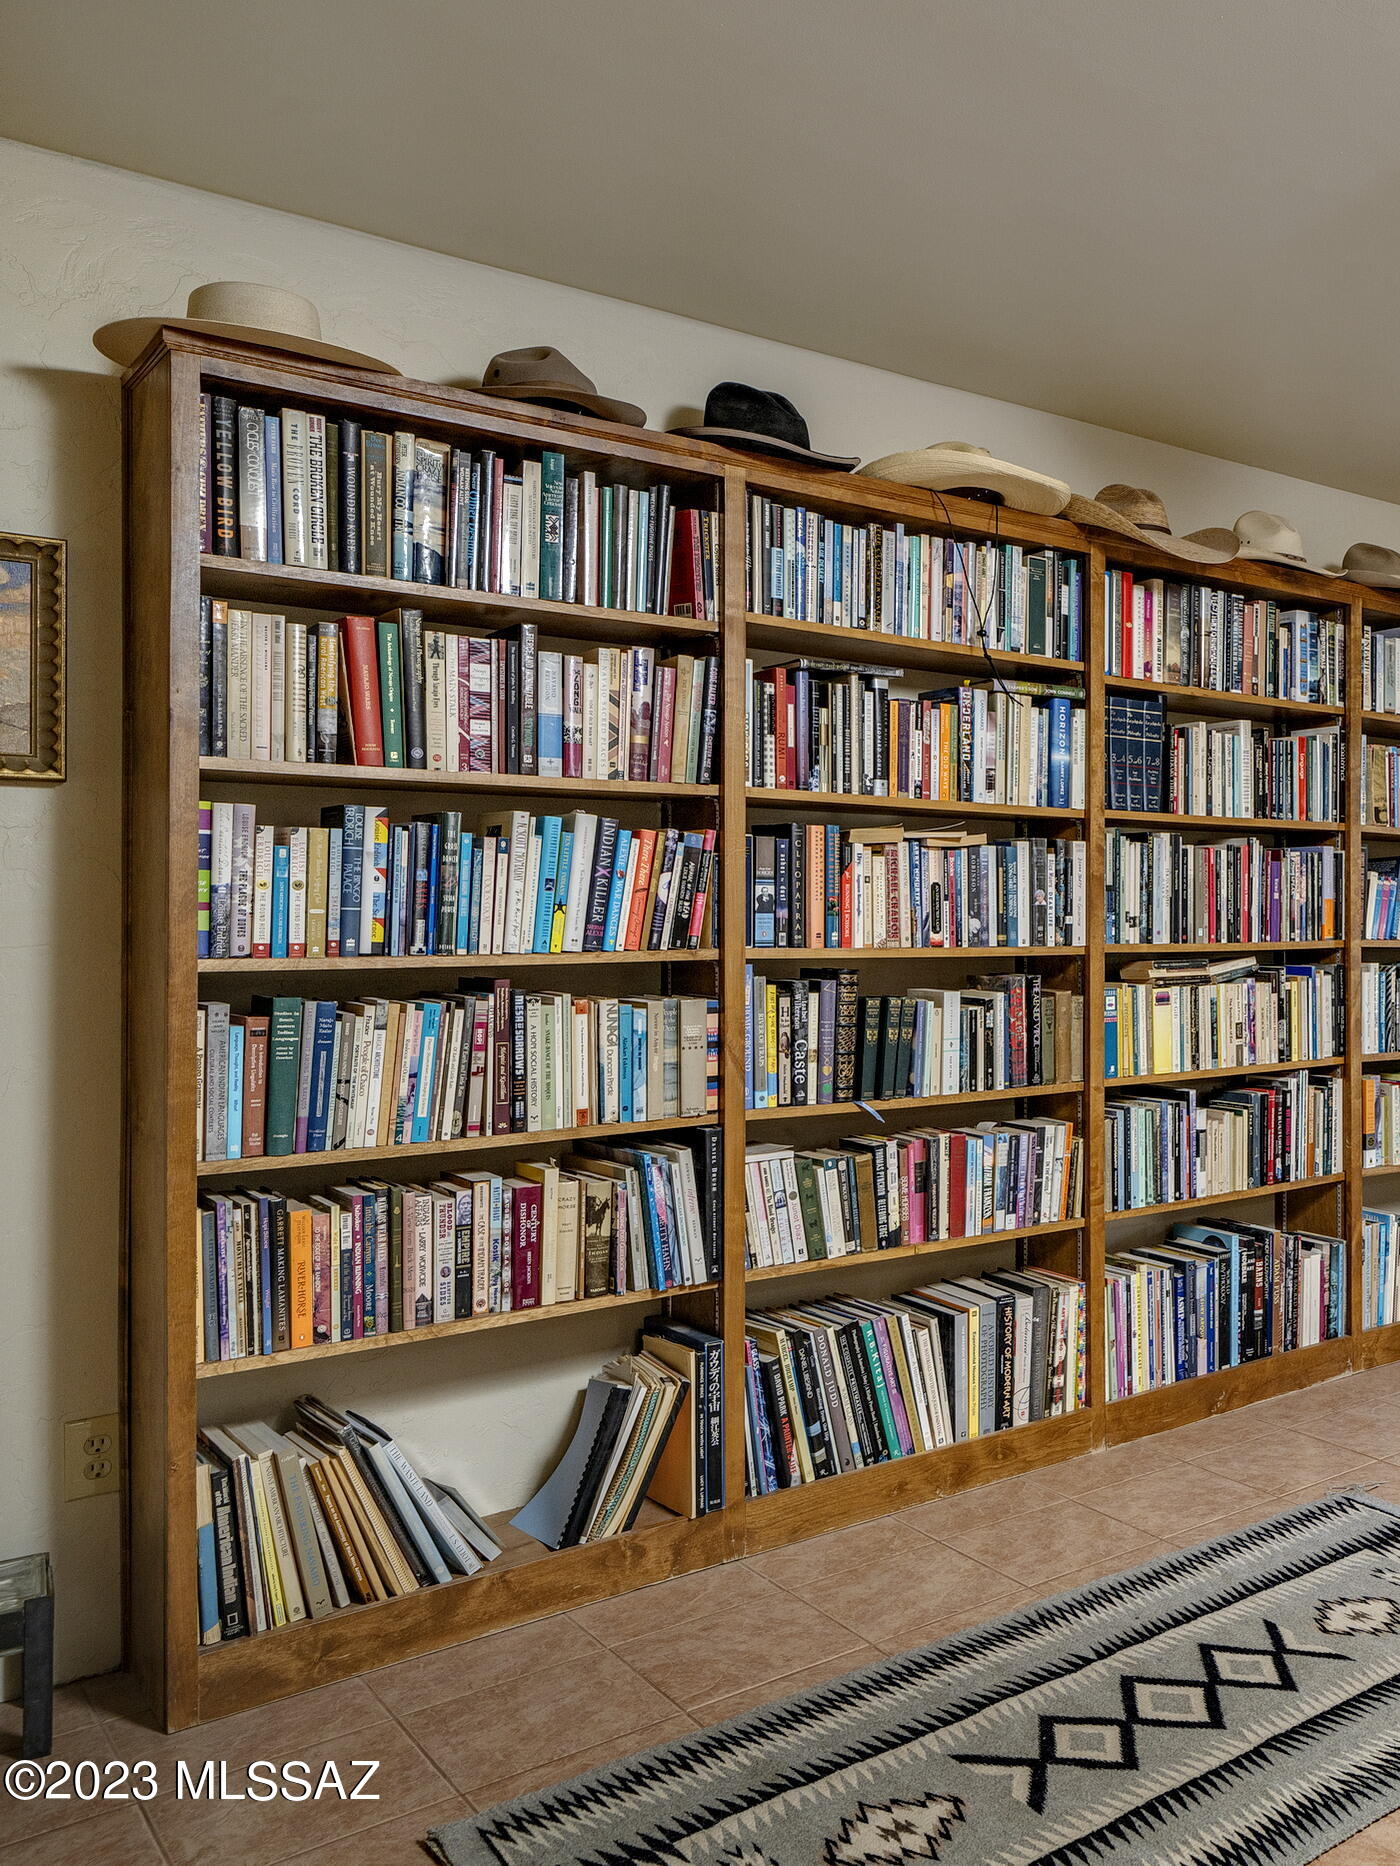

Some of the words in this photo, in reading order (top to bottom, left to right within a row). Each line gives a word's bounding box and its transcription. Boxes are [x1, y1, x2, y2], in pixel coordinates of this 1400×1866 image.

[216, 419, 233, 489] YELLOW
[309, 435, 322, 456] THE
[287, 444, 304, 486] BROKEN
[370, 465, 375, 475] at
[310, 459, 323, 504] BROKEN
[347, 467, 355, 521] WOUNDED
[395, 470, 406, 496] INDIAN
[376, 497, 382, 510] My
[395, 497, 407, 534] COUNTRY
[469, 490, 477, 519] Other
[217, 497, 234, 538] BIRD
[311, 506, 324, 544] CIRCLE
[347, 524, 356, 552] KNEE
[467, 522, 477, 565] Destinies
[230, 619, 239, 642] JERRY
[240, 620, 247, 632] IN
[320, 638, 328, 656] Rural
[525, 633, 534, 654] FIERCE
[231, 644, 239, 677] MANDER
[240, 650, 248, 682] ABSENCE
[328, 638, 337, 679] Electrifying
[525, 655, 534, 667] AND
[362, 664, 370, 689] NAVAJO
[709, 667, 717, 683] CODE
[240, 684, 248, 694] OF
[708, 684, 717, 705] TALKER
[240, 697, 248, 712] THE
[240, 712, 248, 742] SACRED
[962, 692, 970, 760] UNDERLAND
[344, 807, 355, 845] ERDRICH
[355, 813, 363, 840] LOUISE
[599, 822, 615, 867] INDIAN
[618, 839, 627, 867] ALEXIE
[641, 839, 652, 861] There
[239, 871, 248, 881] THE
[353, 856, 361, 872] THE
[638, 863, 649, 885] There
[890, 849, 898, 893] MICHAEL
[344, 864, 353, 893] PALACE
[352, 875, 361, 902] BINGO
[613, 881, 622, 901] WAR
[217, 900, 227, 924] Louise
[591, 879, 608, 922] KILLER
[237, 919, 246, 937] DOVES
[609, 903, 620, 937] DANCES
[216, 926, 226, 954] Erdrich
[515, 995, 524, 1022] MESA
[364, 1016, 372, 1035] Frazier
[606, 1003, 617, 1047] NUNAGA
[362, 1041, 370, 1062] People
[515, 1030, 524, 1075] SORROWS
[794, 1040, 808, 1084] Caste
[362, 1063, 368, 1073] of
[359, 1074, 367, 1096] Chaco
[606, 1078, 614, 1096] Pryde
[875, 1148, 885, 1171] THOMAS
[876, 1172, 886, 1196] PYNCHON
[365, 1206, 373, 1222] Into
[526, 1220, 530, 1228] OF
[878, 1200, 887, 1224] BLEEDING
[276, 1209, 284, 1245] GARRETT
[365, 1223, 373, 1235] the
[879, 1225, 888, 1238] EDGE
[364, 1236, 373, 1264] Canyon
[418, 1232, 426, 1253] LARRY
[462, 1230, 470, 1263] EMPIRE
[418, 1255, 426, 1287] WOIWODE
[1255, 1261, 1263, 1287] BARNS
[278, 1285, 286, 1331] LAMANITES
[365, 1284, 373, 1311] MOORE
[981, 1325, 987, 1336] OF
[988, 1323, 994, 1331] A
[1003, 1307, 1013, 1344] HISTORY
[751, 1348, 760, 1370] GLASS
[1003, 1347, 1012, 1359] OF
[774, 1374, 786, 1395] DAVID
[817, 1335, 832, 1377] DONALD
[825, 1381, 838, 1408] JUDD
[1003, 1361, 1011, 1398] MODERN
[777, 1398, 788, 1416] PARK
[1002, 1400, 1011, 1417] ART
[782, 1424, 793, 1459] PAINTER'S
[389, 1446, 402, 1465] THE
[416, 1486, 433, 1506] LAND
[215, 1506, 234, 1565] American
[222, 1567, 238, 1603] Indian
